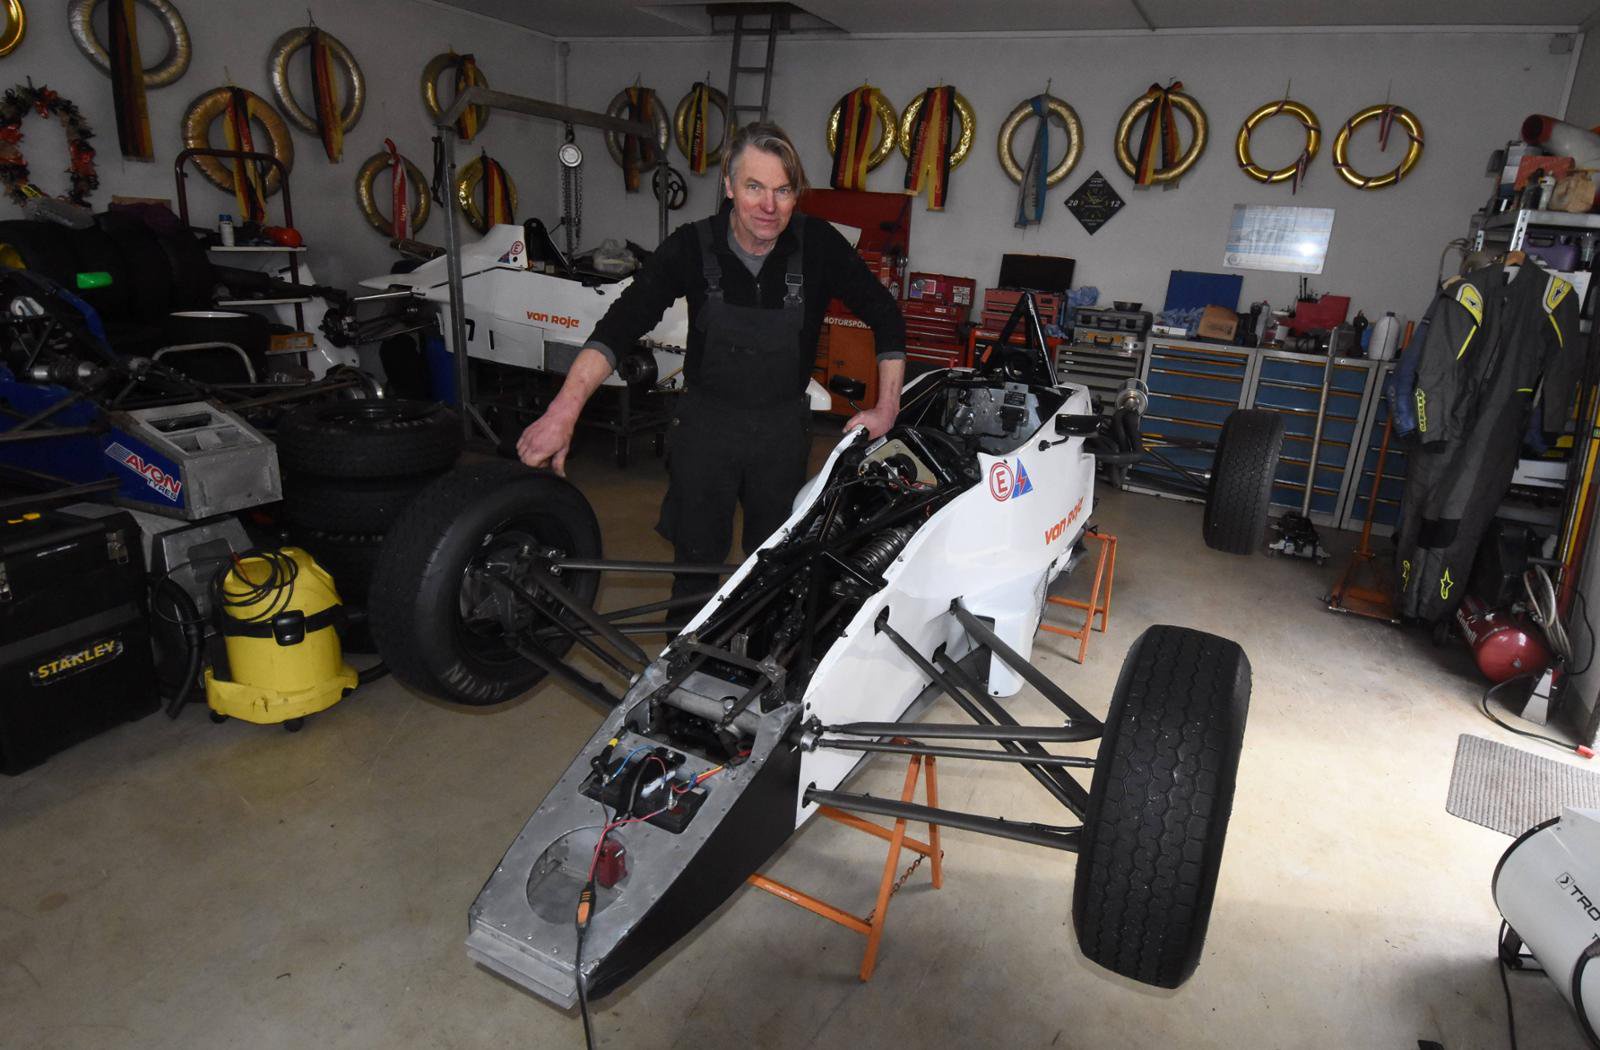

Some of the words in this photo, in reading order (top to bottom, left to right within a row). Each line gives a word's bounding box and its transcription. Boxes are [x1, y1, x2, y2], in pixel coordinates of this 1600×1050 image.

[124, 455, 181, 493] AVON
[995, 470, 1009, 494] E
[147, 478, 178, 500] TYRES
